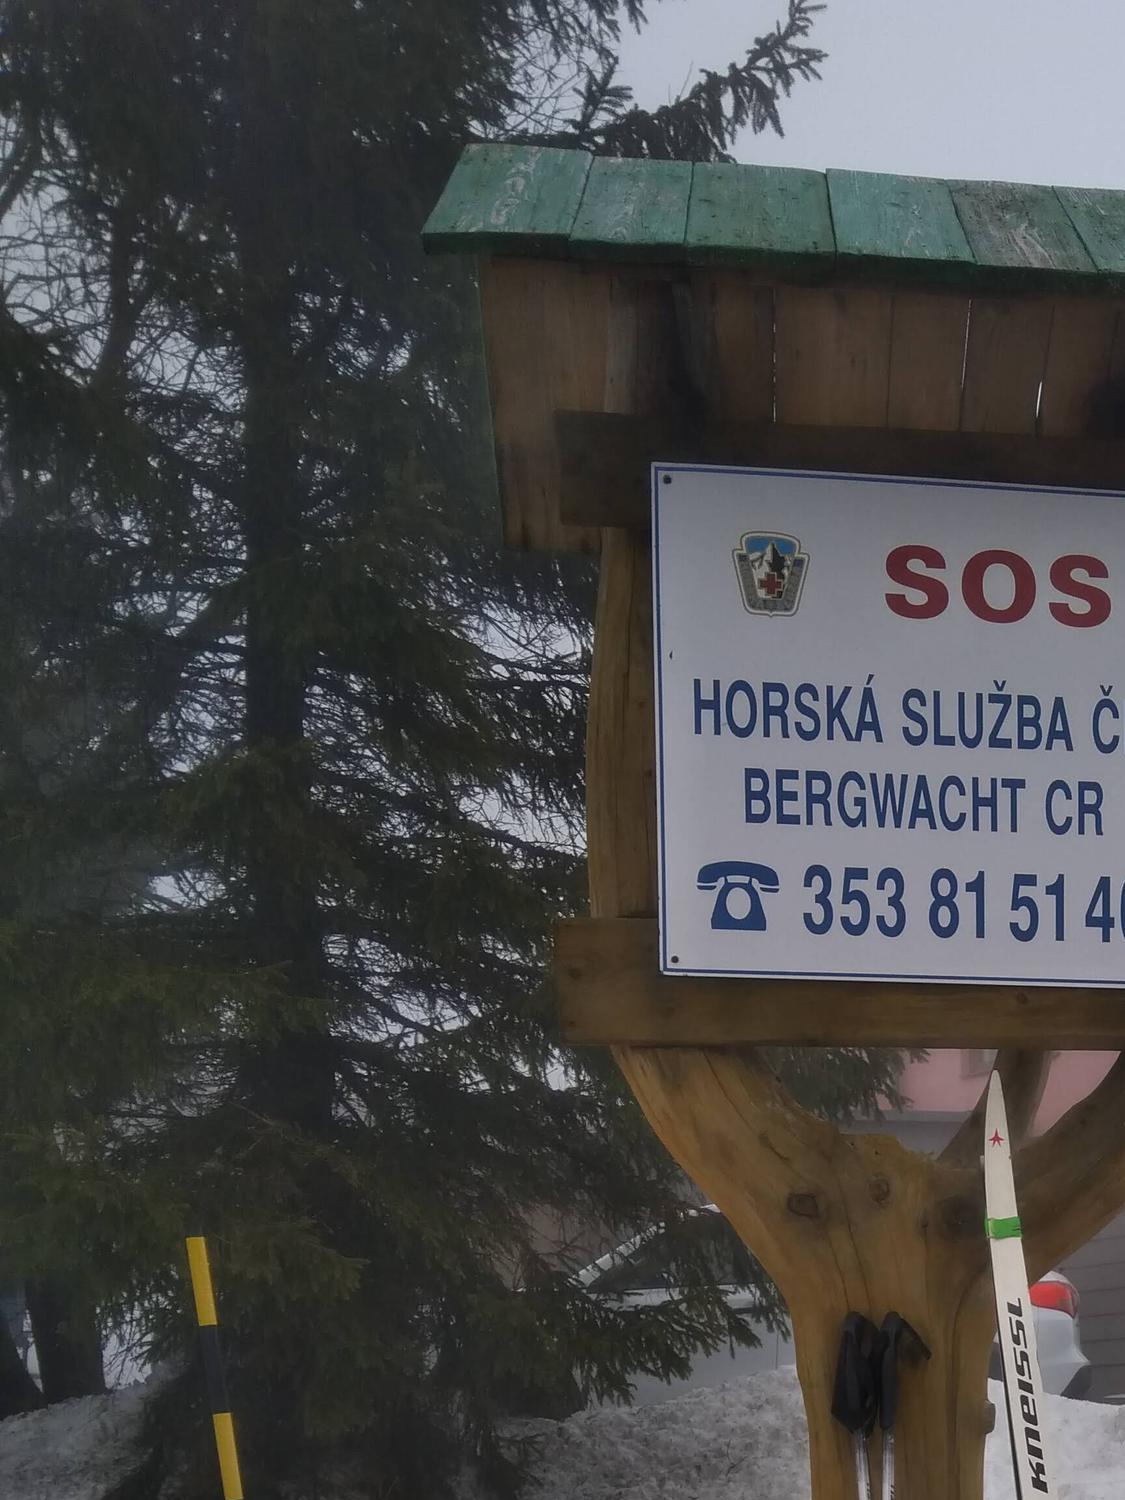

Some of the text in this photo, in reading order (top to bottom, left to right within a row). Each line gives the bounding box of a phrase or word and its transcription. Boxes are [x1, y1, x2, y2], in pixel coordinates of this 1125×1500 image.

[884, 544, 1112, 628] SOS
[692, 673, 884, 744] HORSKÁ
[901, 679, 1074, 752] SLUŽBA
[743, 767, 1104, 836] BERGWACHT CR
[802, 864, 907, 938] 353
